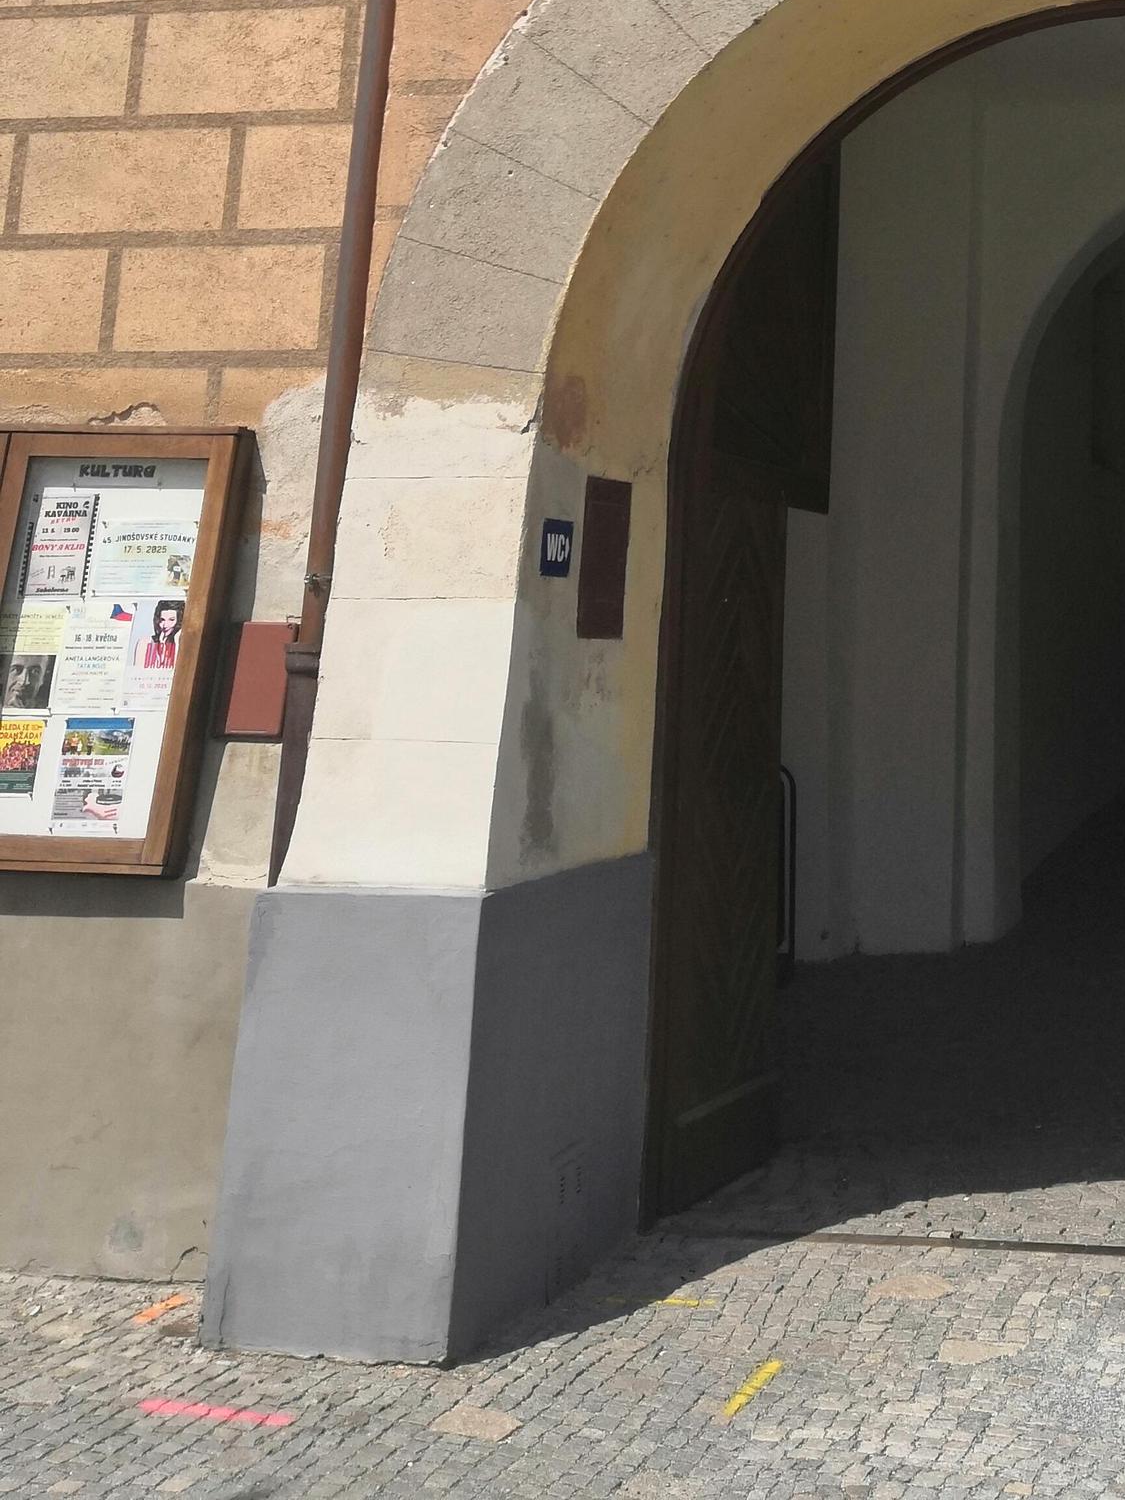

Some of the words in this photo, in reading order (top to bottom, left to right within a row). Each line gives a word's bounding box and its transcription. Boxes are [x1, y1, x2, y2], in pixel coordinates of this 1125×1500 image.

[56, 501, 79, 509] KINO
[44, 509, 88, 517] KAVÁRNA
[146, 545, 167, 553] 2025
[546, 533, 565, 562] WC
